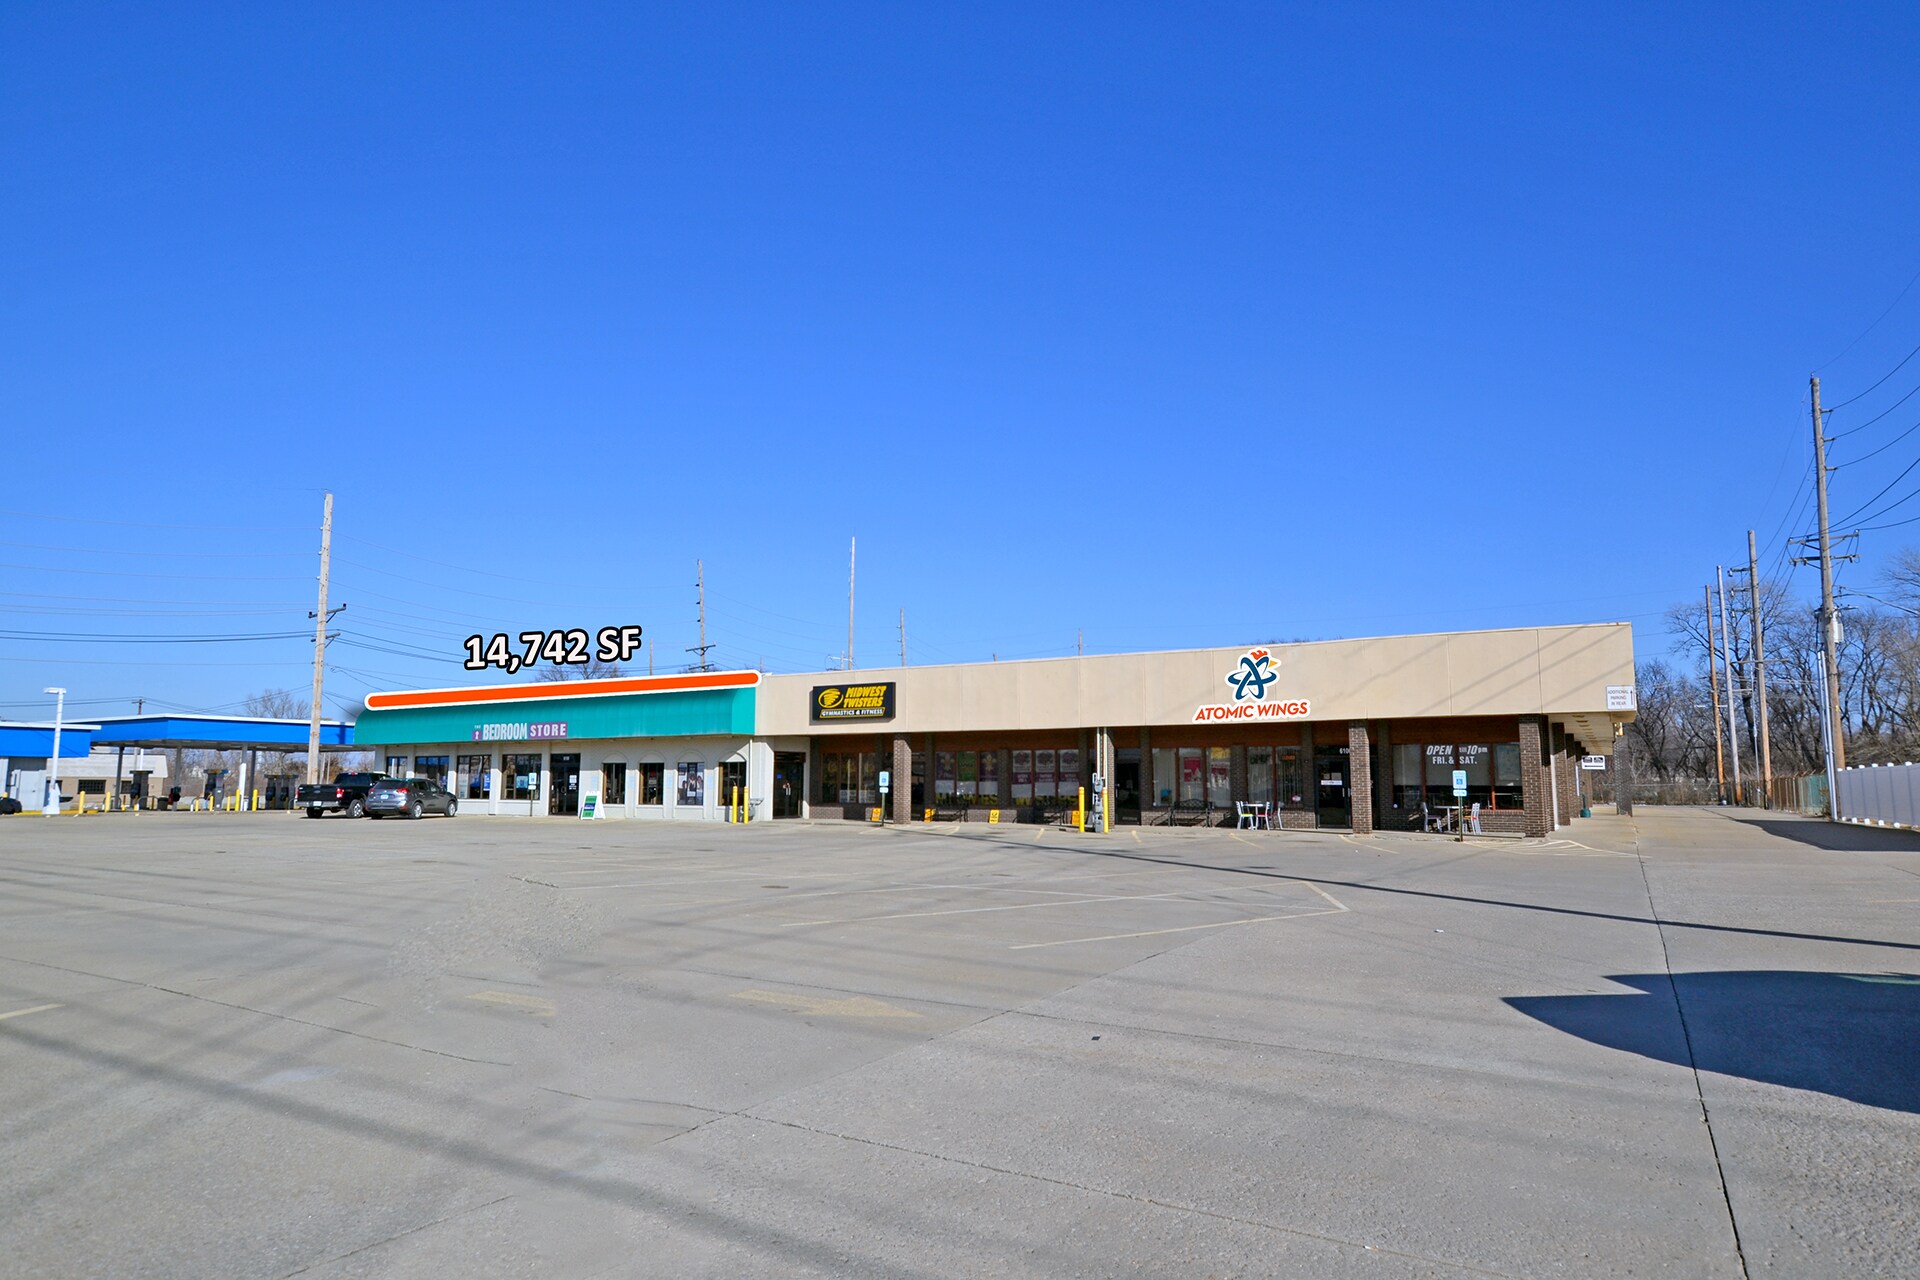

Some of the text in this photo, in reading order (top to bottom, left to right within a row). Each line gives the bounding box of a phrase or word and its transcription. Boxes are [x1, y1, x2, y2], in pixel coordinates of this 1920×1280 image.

[845, 685, 887, 698] MIDWEST
[843, 696, 884, 708] TWISTERS
[821, 709, 855, 717] GYMNASTICS
[1195, 701, 1308, 721] ATOMIC WINGS
[482, 722, 567, 741] BEDROOM STORE
[1426, 745, 1453, 756] OPEN
[1432, 755, 1448, 765] FRI.
[1459, 755, 1478, 765] SAT.
